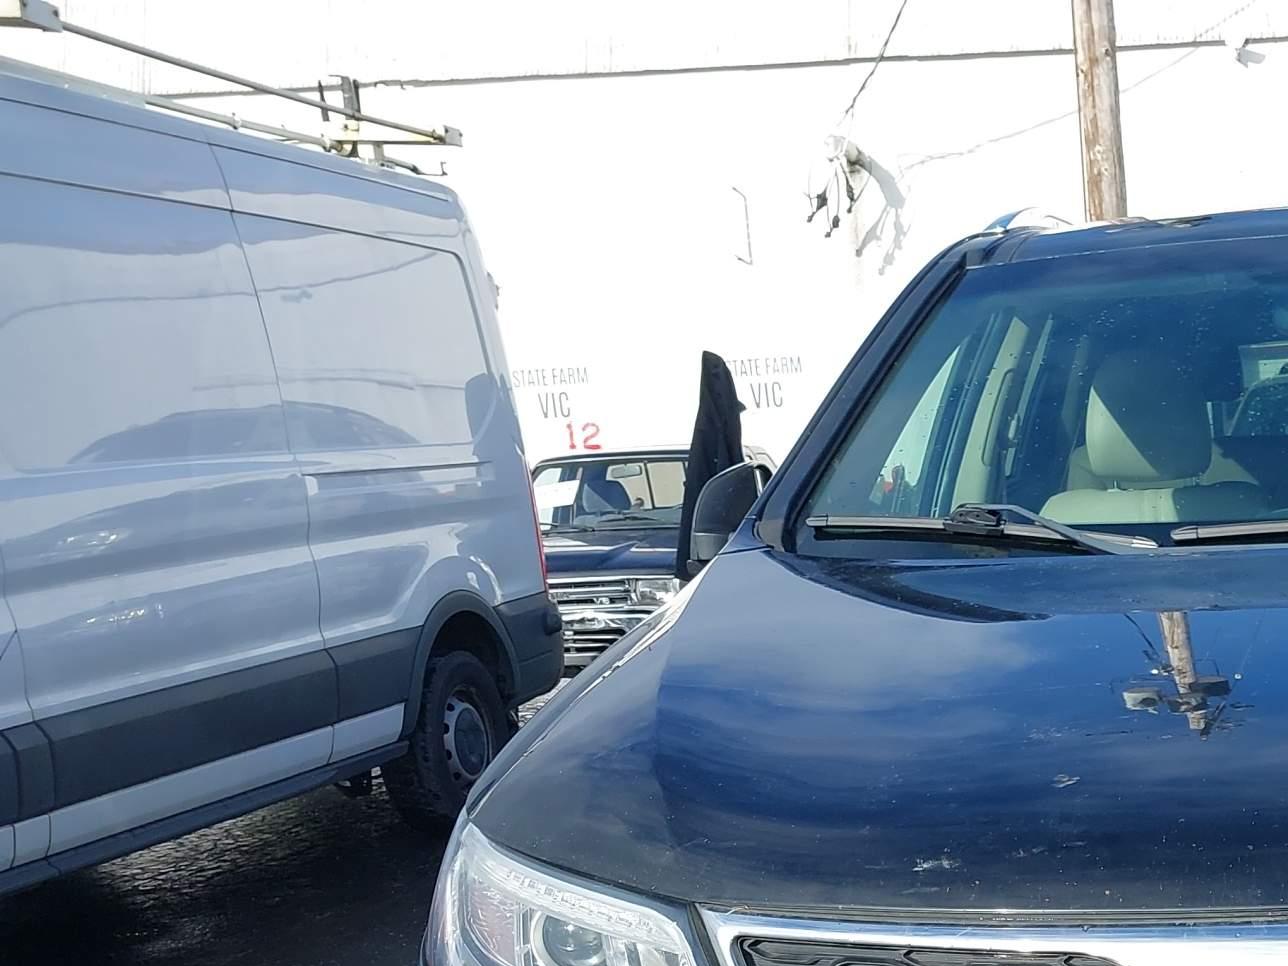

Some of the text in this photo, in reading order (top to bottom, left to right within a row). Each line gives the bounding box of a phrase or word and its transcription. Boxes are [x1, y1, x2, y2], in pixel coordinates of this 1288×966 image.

[512, 367, 588, 388] STATE FARM
[765, 356, 802, 375] FARM
[537, 391, 571, 419] VIC
[749, 381, 783, 408] VIC
[565, 422, 604, 450] 12
